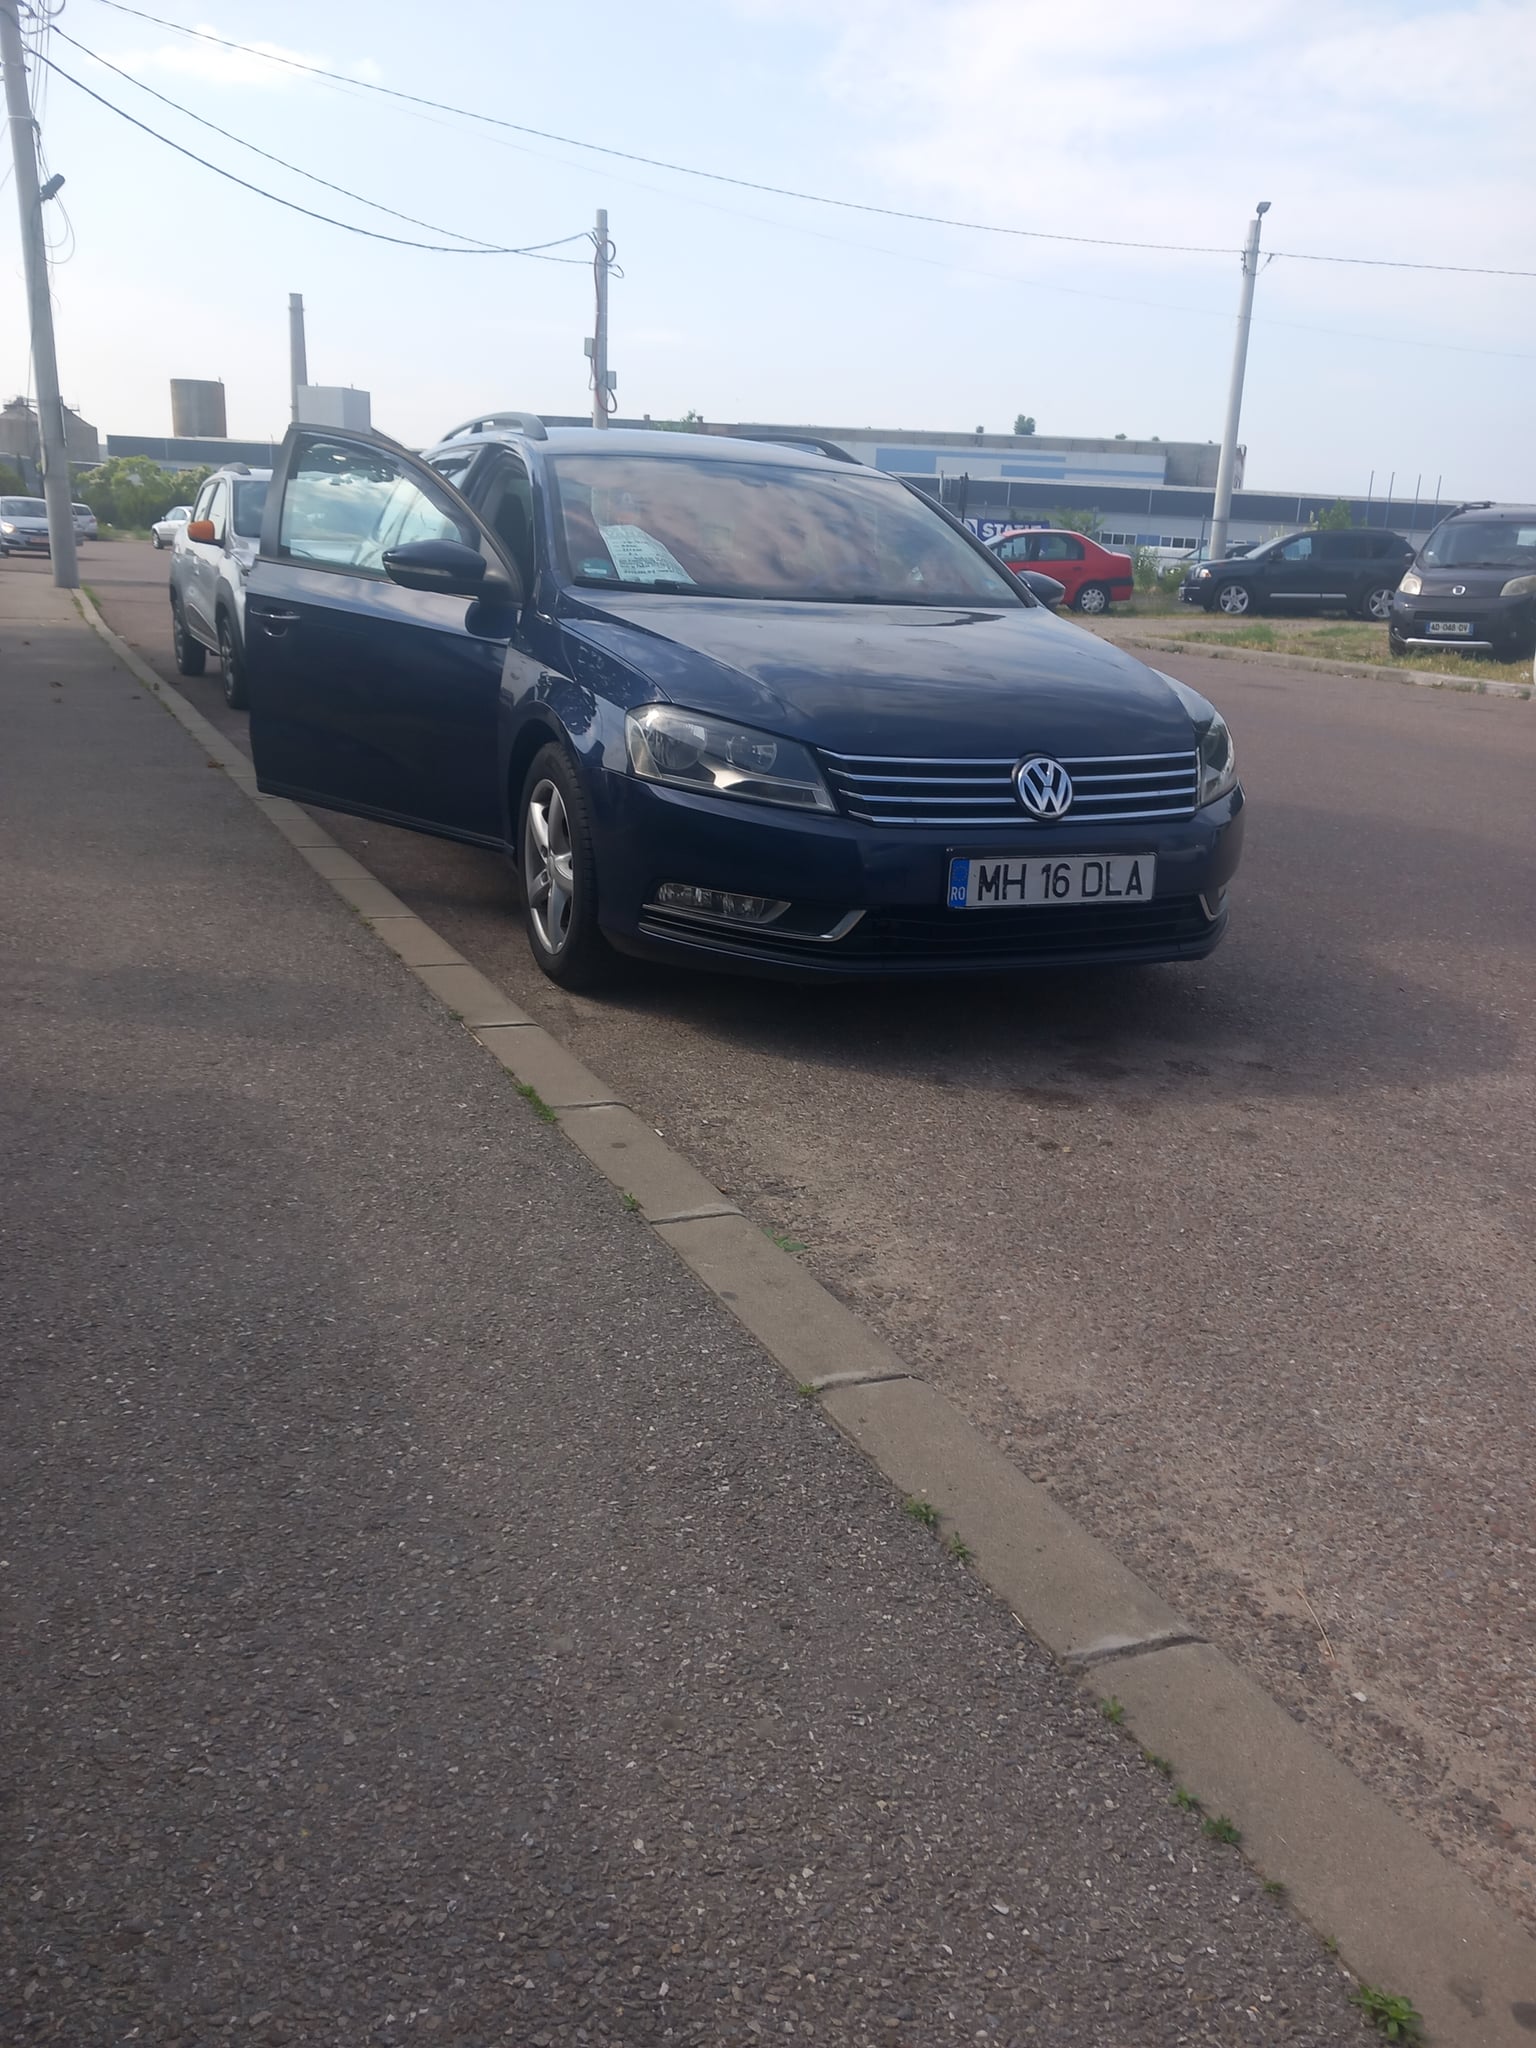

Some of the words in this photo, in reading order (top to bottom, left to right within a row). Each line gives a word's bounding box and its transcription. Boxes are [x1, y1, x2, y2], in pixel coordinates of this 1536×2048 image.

[982, 523, 1042, 538] STA
[1018, 757, 1073, 818] VW
[951, 886, 966, 901] RO
[977, 864, 1027, 901] MH
[1041, 863, 1071, 899] 16
[1081, 860, 1143, 897] DLA
